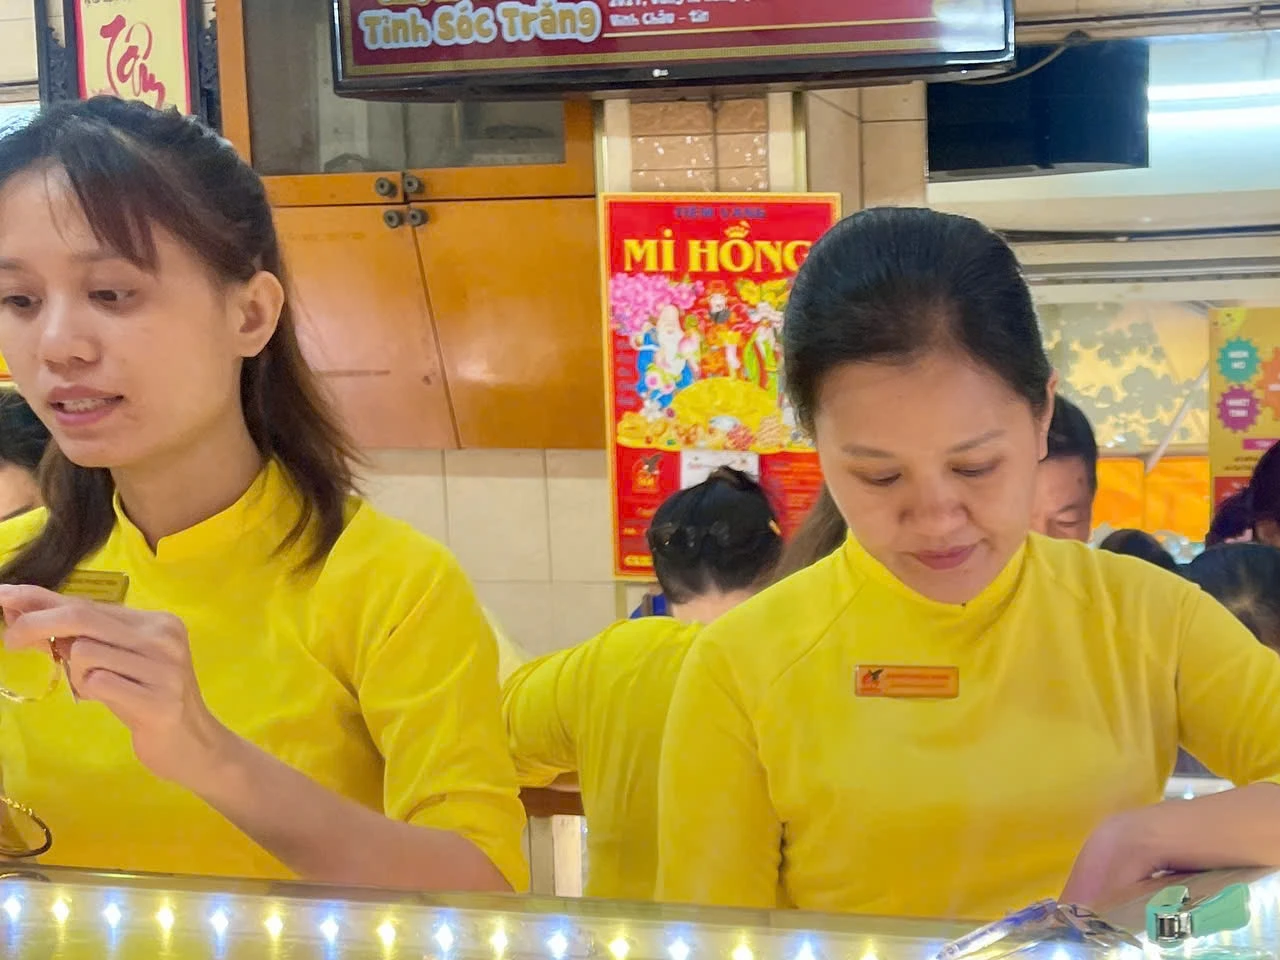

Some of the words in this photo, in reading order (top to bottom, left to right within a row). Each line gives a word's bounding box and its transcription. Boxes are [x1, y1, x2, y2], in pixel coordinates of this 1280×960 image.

[362, 13, 429, 45] Tỉnh
[437, 6, 495, 41] Sóc
[502, 1, 597, 39] Trăng
